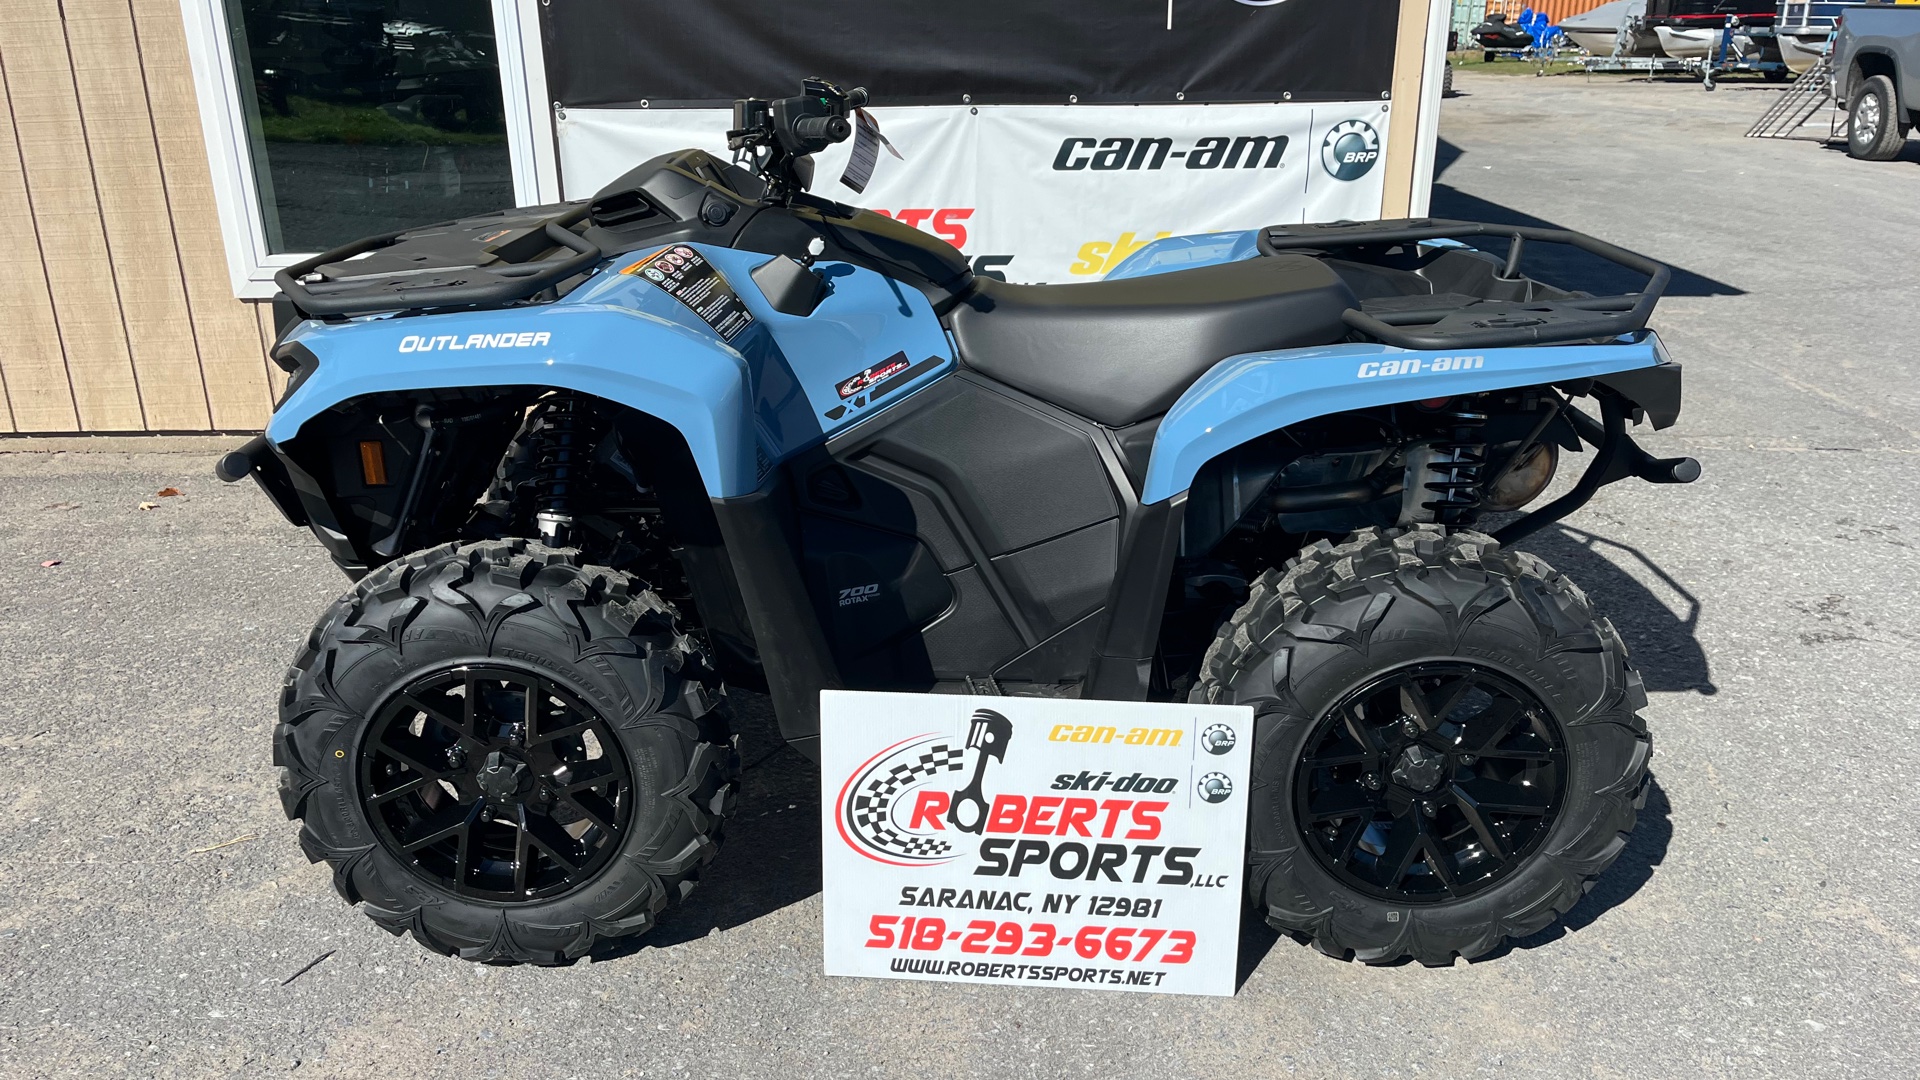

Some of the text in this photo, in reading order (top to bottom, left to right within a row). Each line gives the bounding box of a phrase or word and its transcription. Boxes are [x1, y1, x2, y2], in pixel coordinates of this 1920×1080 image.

[1052, 135, 1290, 171] can-am
[1343, 150, 1377, 163] BRP
[398, 331, 551, 353] OUTLANDER
[1357, 355, 1484, 379] can-am
[842, 386, 876, 414] XT
[839, 583, 879, 600] 700
[839, 594, 869, 607] ROTAX
[1048, 724, 1183, 747] can-am
[1050, 770, 1179, 794] ski-doo
[909, 790, 1169, 841] ROBERTS
[898, 886, 1163, 919] SARANAC, NY 12981
[865, 914, 1197, 965] 518-293-6673
[890, 958, 1167, 987] WWW.ROBERTSSPORTS.NET
